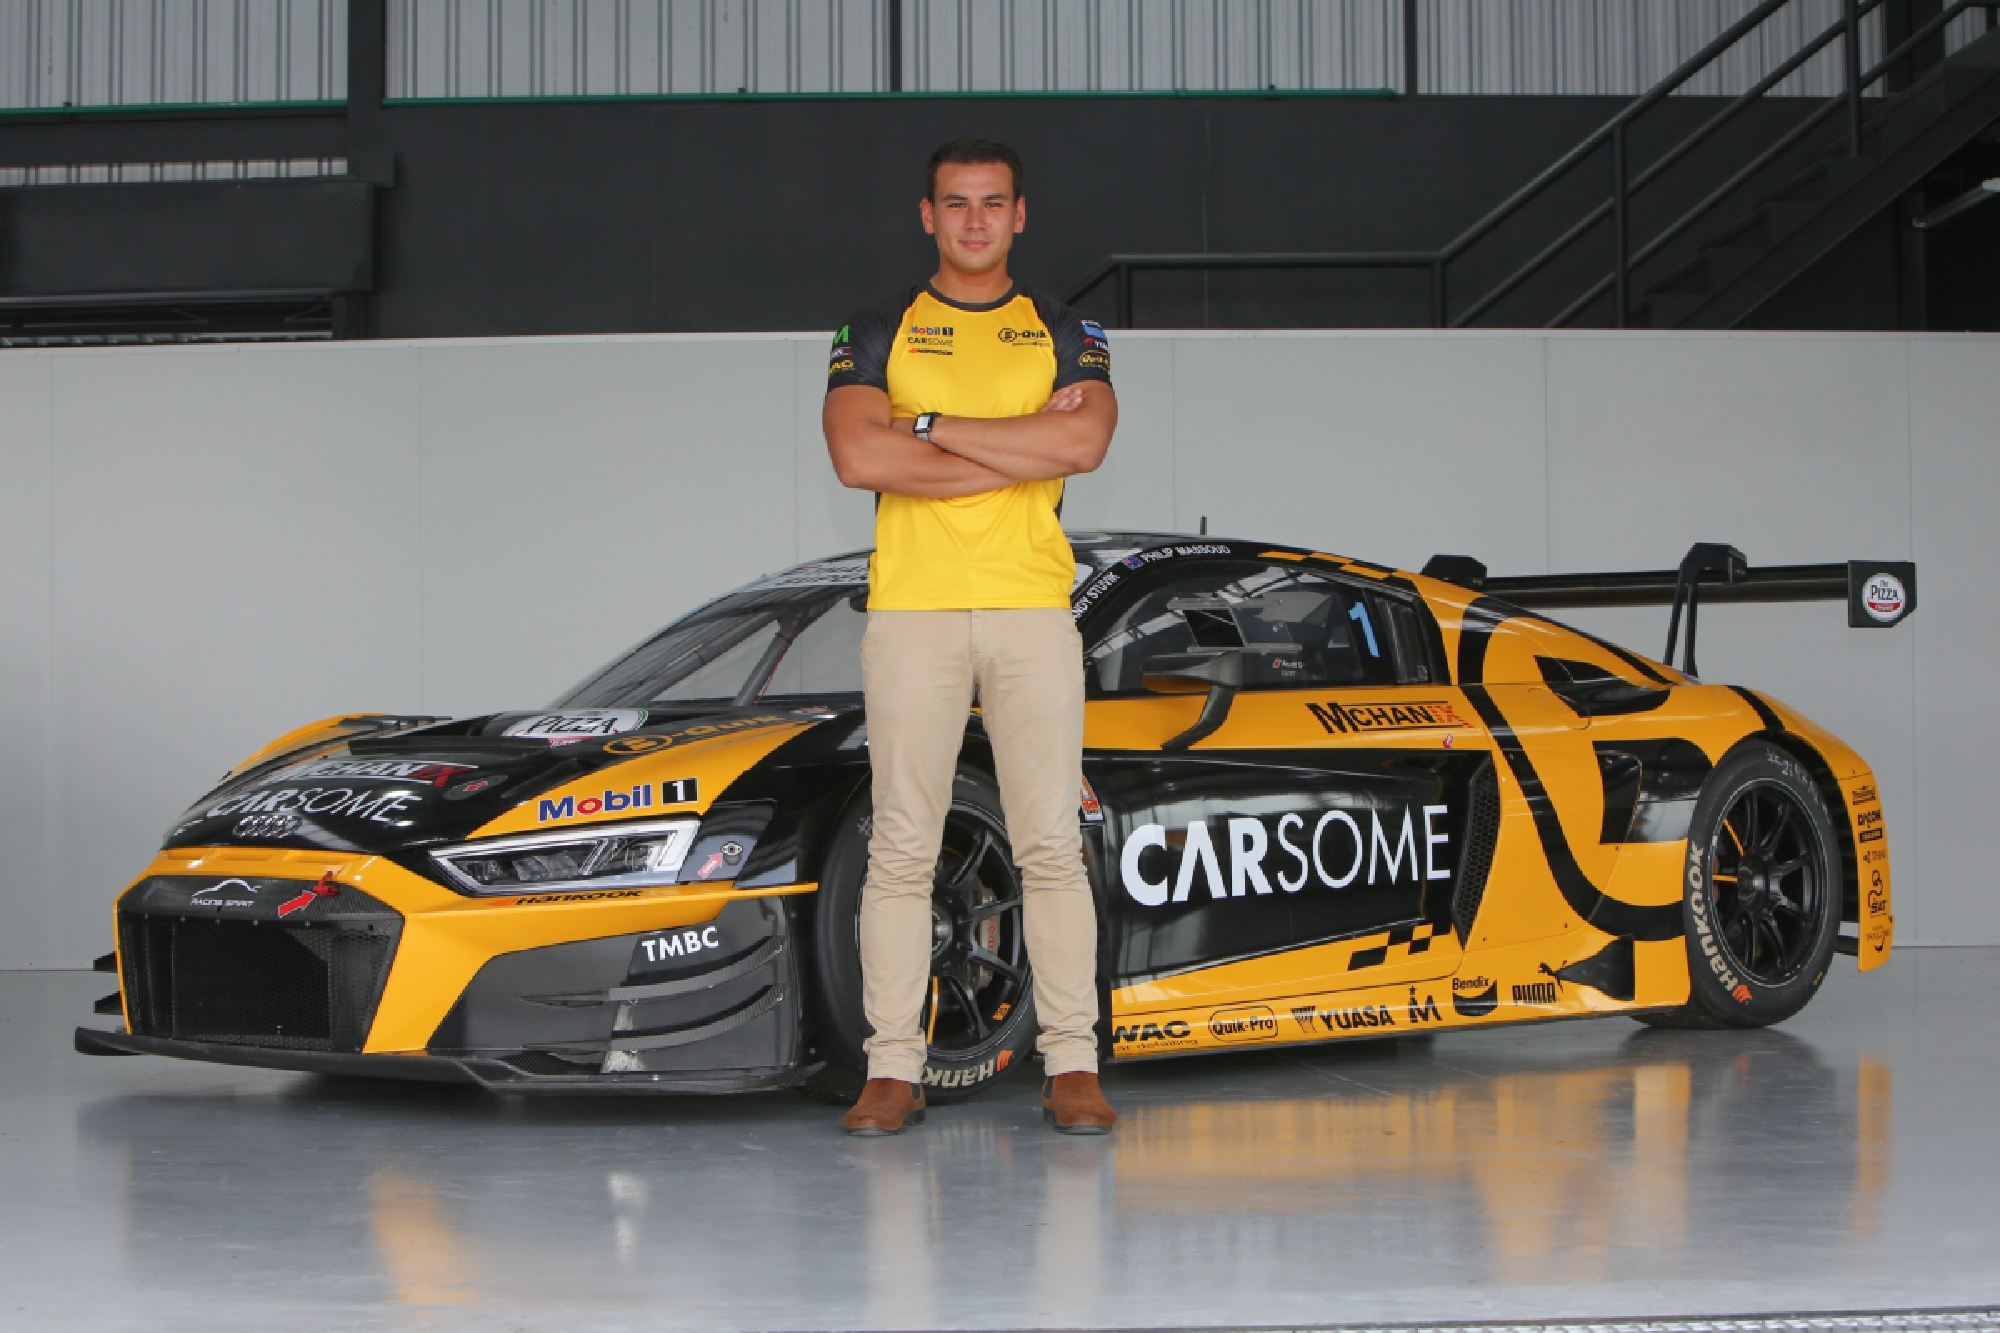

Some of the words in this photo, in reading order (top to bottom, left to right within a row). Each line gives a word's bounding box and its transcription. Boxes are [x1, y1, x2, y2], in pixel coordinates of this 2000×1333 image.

[1140, 548, 1173, 562] PHILIP
[1175, 544, 1230, 555] MASSOUD
[1870, 585, 1899, 600] PIZZA
[1348, 602, 1379, 658] 1
[526, 716, 618, 734] PIZZA
[205, 788, 421, 822] CARSOME
[538, 783, 653, 823] Mobil
[1121, 803, 1451, 906] CARSOME
[641, 926, 719, 962] TMBC
[1452, 976, 1489, 990] Bendix
[1512, 982, 1558, 1005] PUMA
[1318, 1004, 1397, 1031] YUASA
